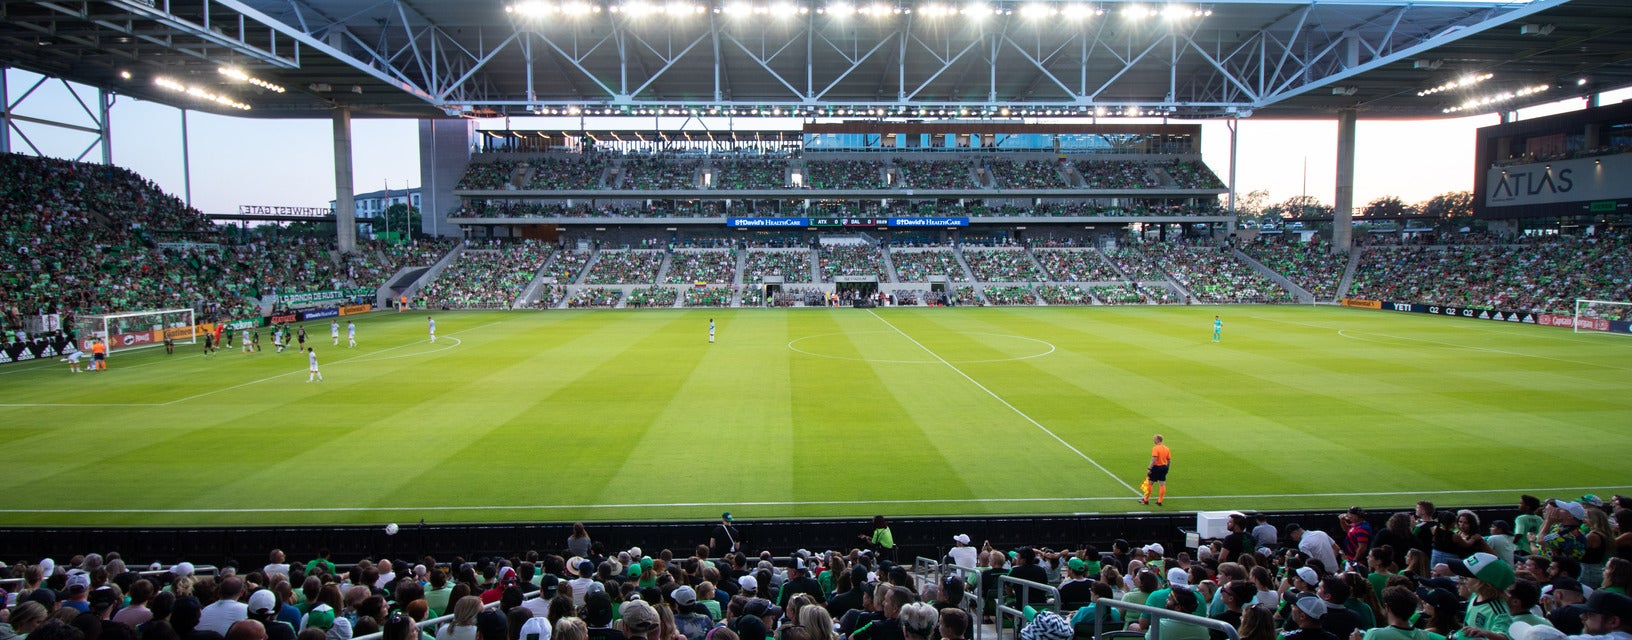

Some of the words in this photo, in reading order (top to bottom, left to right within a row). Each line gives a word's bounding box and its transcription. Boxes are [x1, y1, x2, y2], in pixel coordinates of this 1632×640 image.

[1492, 168, 1573, 198] ATLAS
[290, 293, 313, 302] BANDA
[1394, 303, 1412, 312] YETI
[1552, 316, 1571, 327] Captain
